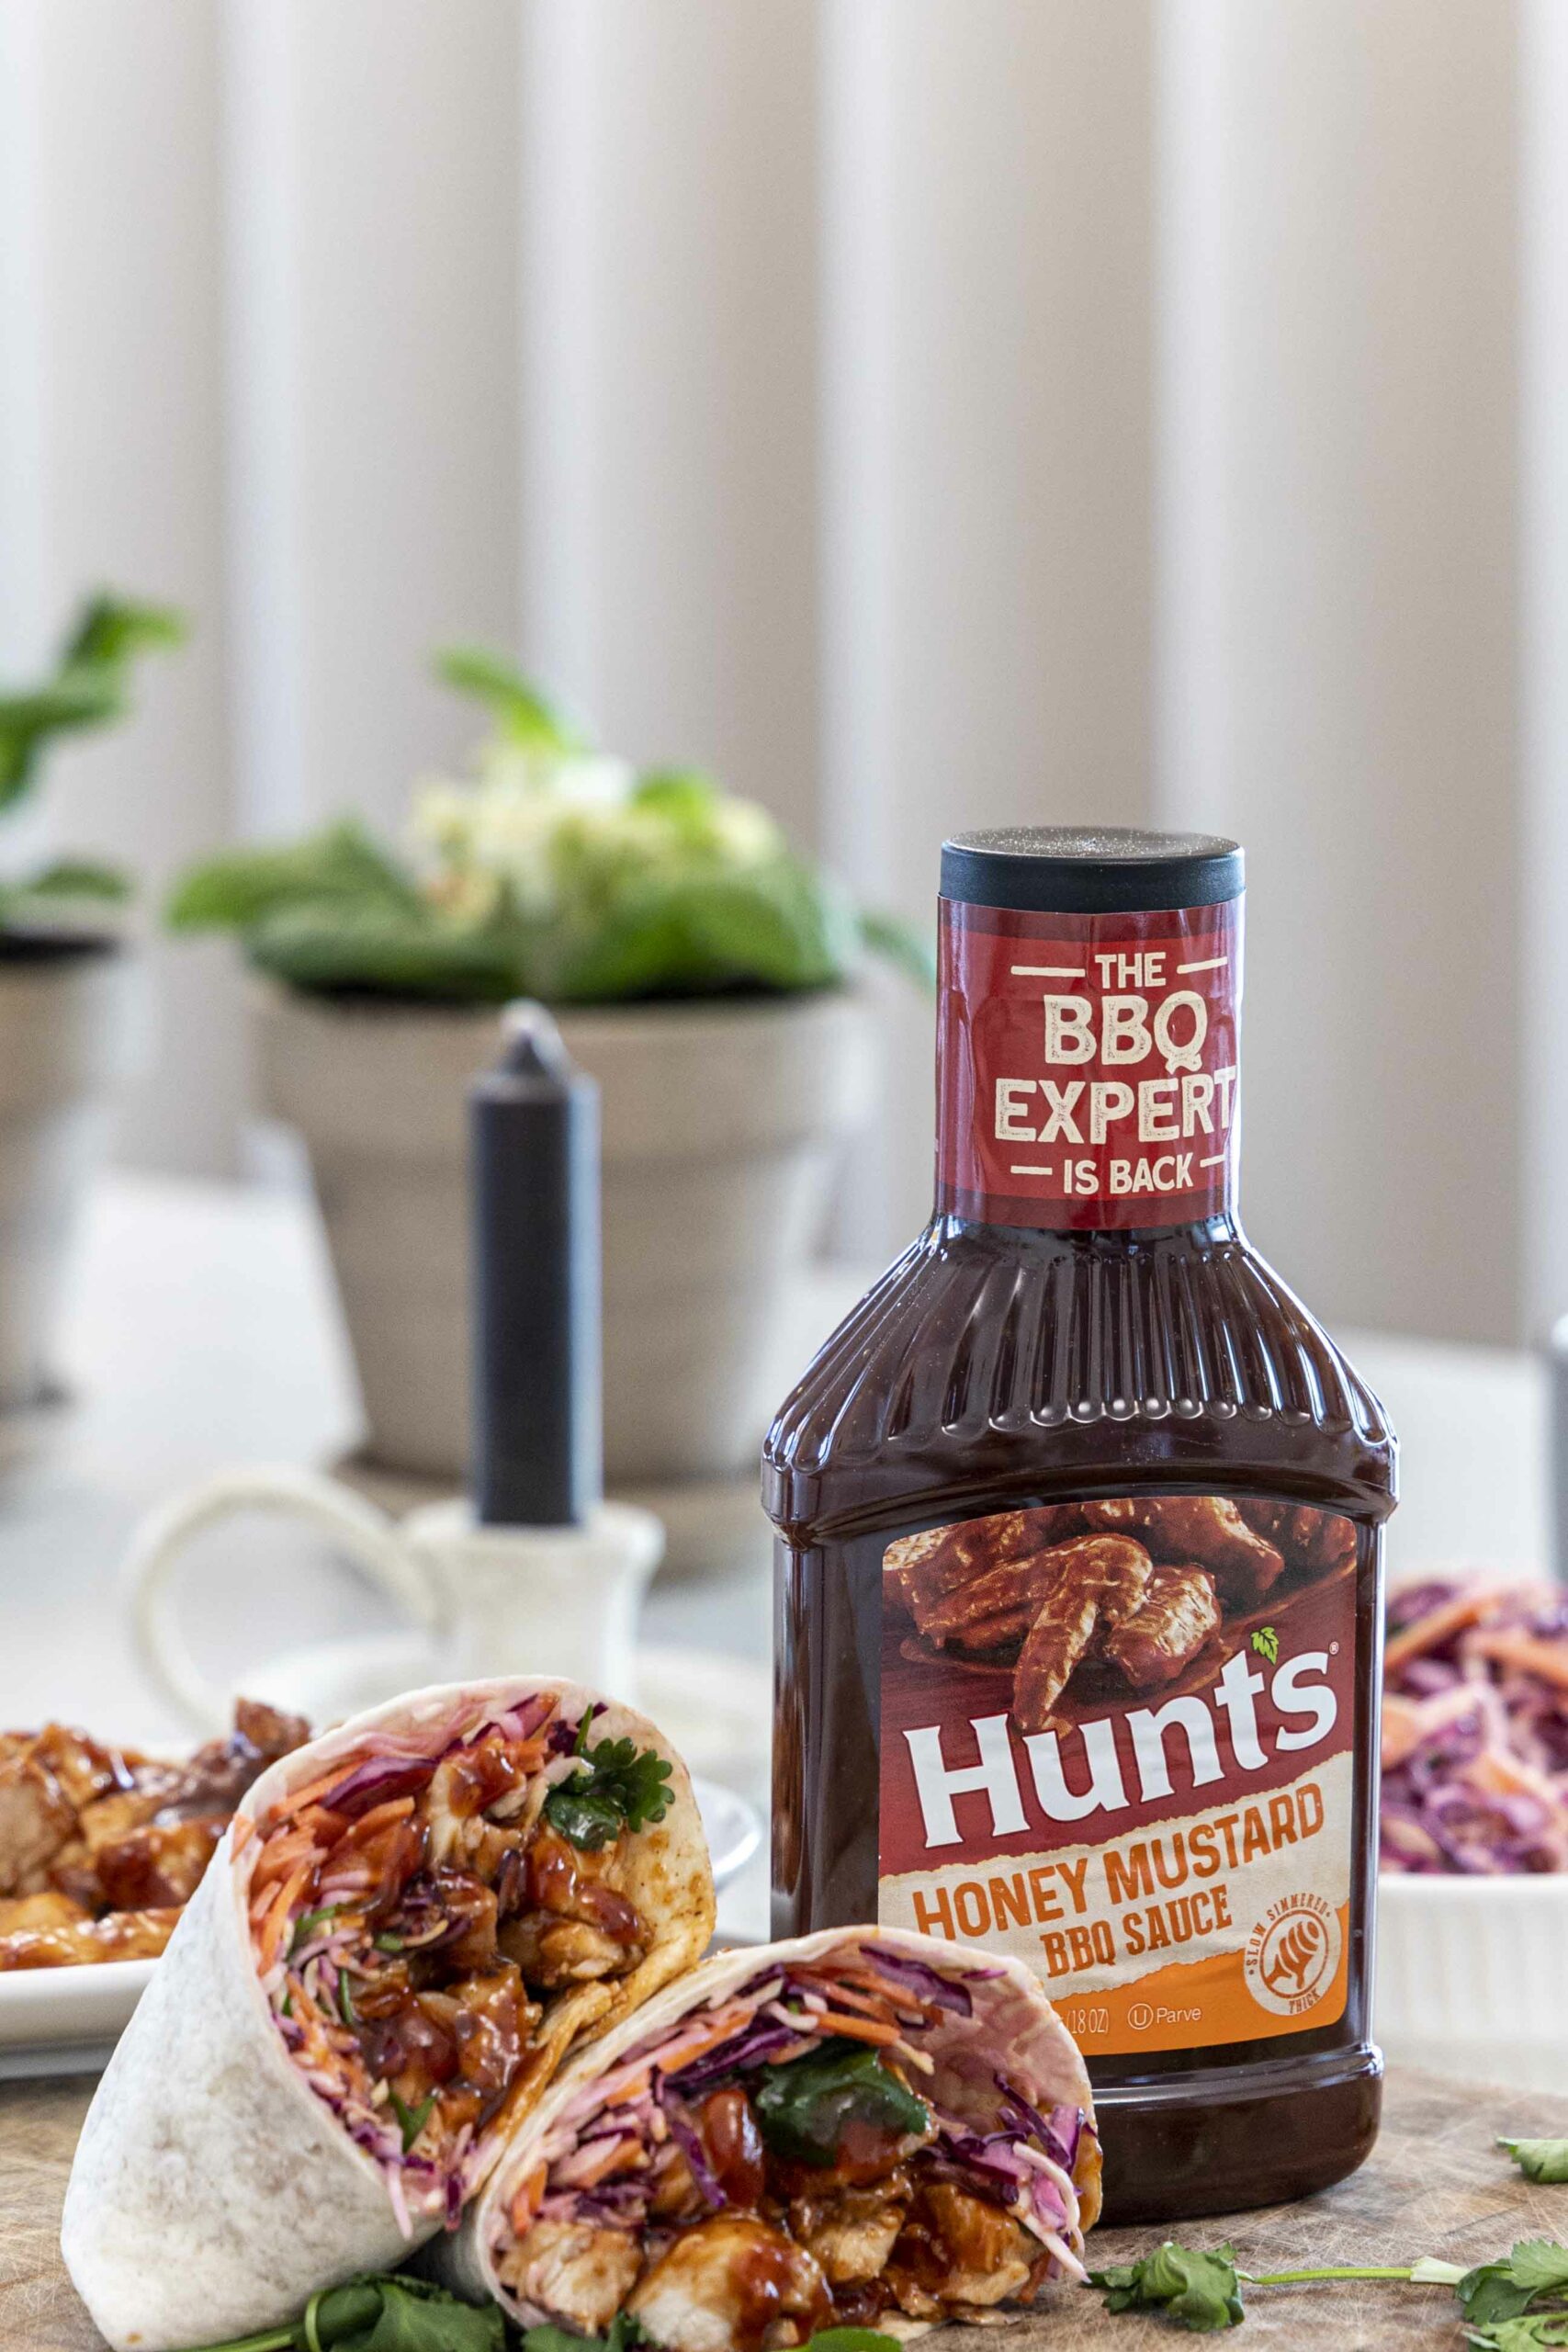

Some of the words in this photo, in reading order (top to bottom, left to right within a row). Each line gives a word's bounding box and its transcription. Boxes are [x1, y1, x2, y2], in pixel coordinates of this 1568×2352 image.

[1094, 951, 1167, 989] THE
[1043, 989, 1208, 1074] BBQ
[994, 1064, 1236, 1145] EXPERT
[1062, 1159, 1100, 1194] IS
[1109, 1151, 1194, 1194] BACK
[912, 1857, 1089, 1941] HONEY
[1102, 1781, 1325, 1905] MUSTARD
[1039, 1919, 1117, 1978] BBQ
[1122, 1883, 1233, 1956] SAUCE
[1246, 1922, 1267, 1967] SLOW
[1266, 1892, 1330, 1921] SIMMERED
[1089, 2007, 1110, 2034] OZ)
[1156, 2007, 1202, 2024] Parve
[1289, 1987, 1322, 2014] THICK
